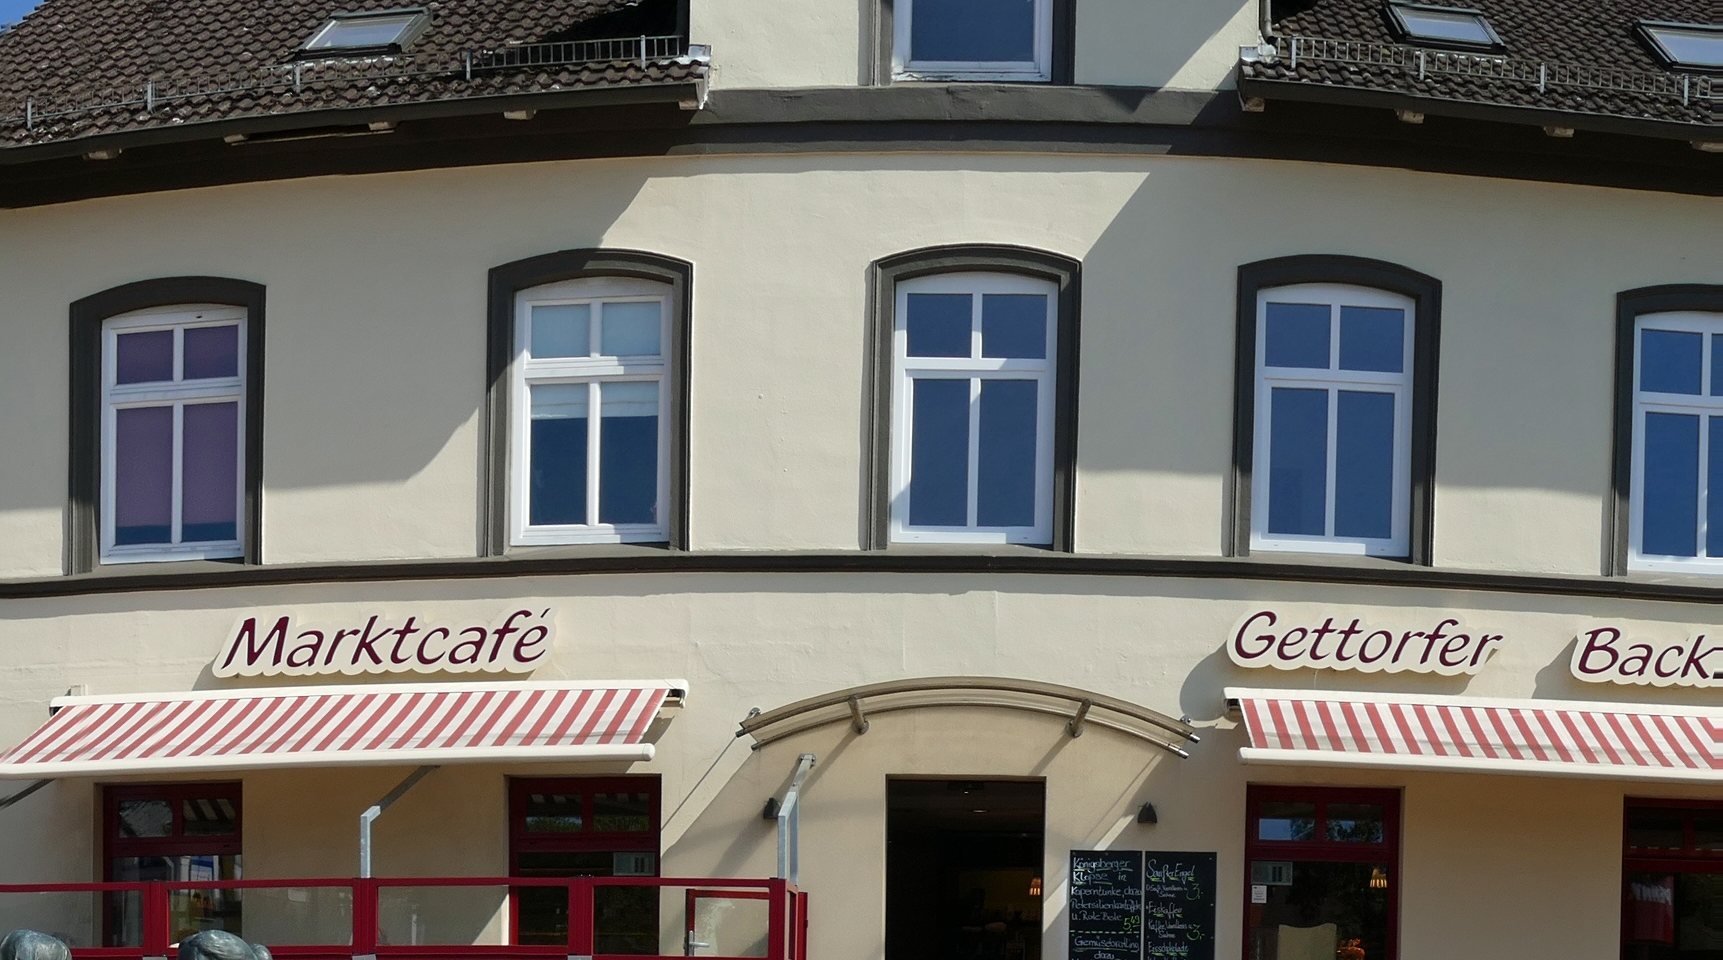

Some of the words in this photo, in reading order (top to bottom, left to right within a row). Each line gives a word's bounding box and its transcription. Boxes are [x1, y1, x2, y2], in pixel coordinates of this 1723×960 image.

[220, 607, 551, 670] Marktcafé
[1233, 610, 1504, 667] Gettorfer
[1577, 627, 1723, 680] Back
